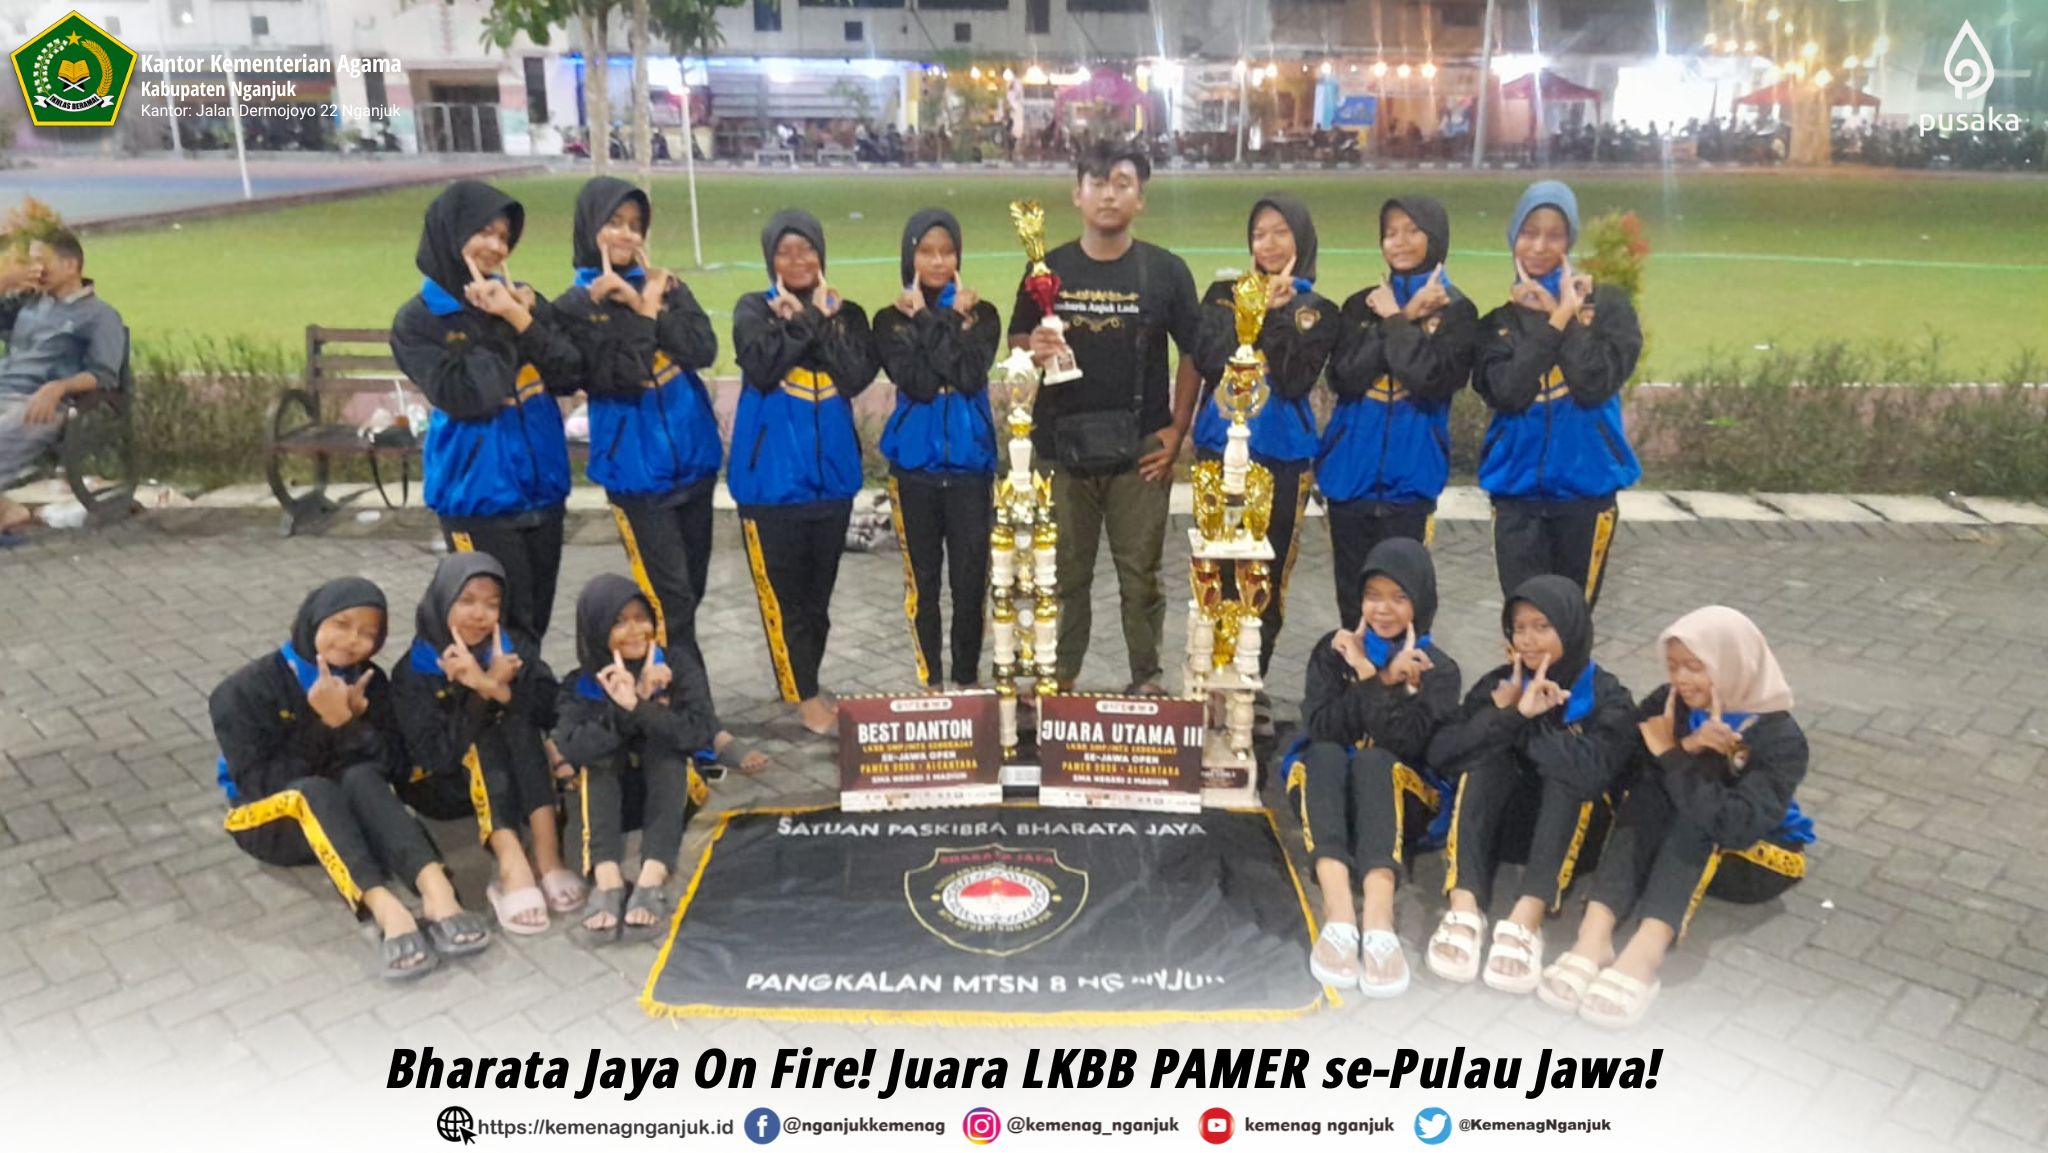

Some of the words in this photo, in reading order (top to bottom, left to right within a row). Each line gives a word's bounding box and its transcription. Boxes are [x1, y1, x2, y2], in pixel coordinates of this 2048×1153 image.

[858, 721, 901, 744] BEST
[905, 719, 974, 742] DANTON
[1042, 720, 1104, 742] JUARA
[1111, 722, 1176, 746] UTAMA
[1183, 726, 1203, 747] III
[881, 752, 927, 763] SE-JAWA
[929, 751, 957, 761] OPEN
[1083, 752, 1130, 763] SE-JAWA
[1131, 754, 1160, 764] OPEN
[777, 815, 880, 837] SATUAN
[888, 821, 1008, 837] PASKIBRA
[1016, 821, 1137, 837] BHARATA
[1145, 821, 1208, 837] JAYA
[745, 970, 943, 993] PANGKALAN
[952, 973, 1039, 994] MTSN
[1049, 974, 1067, 994] 8
